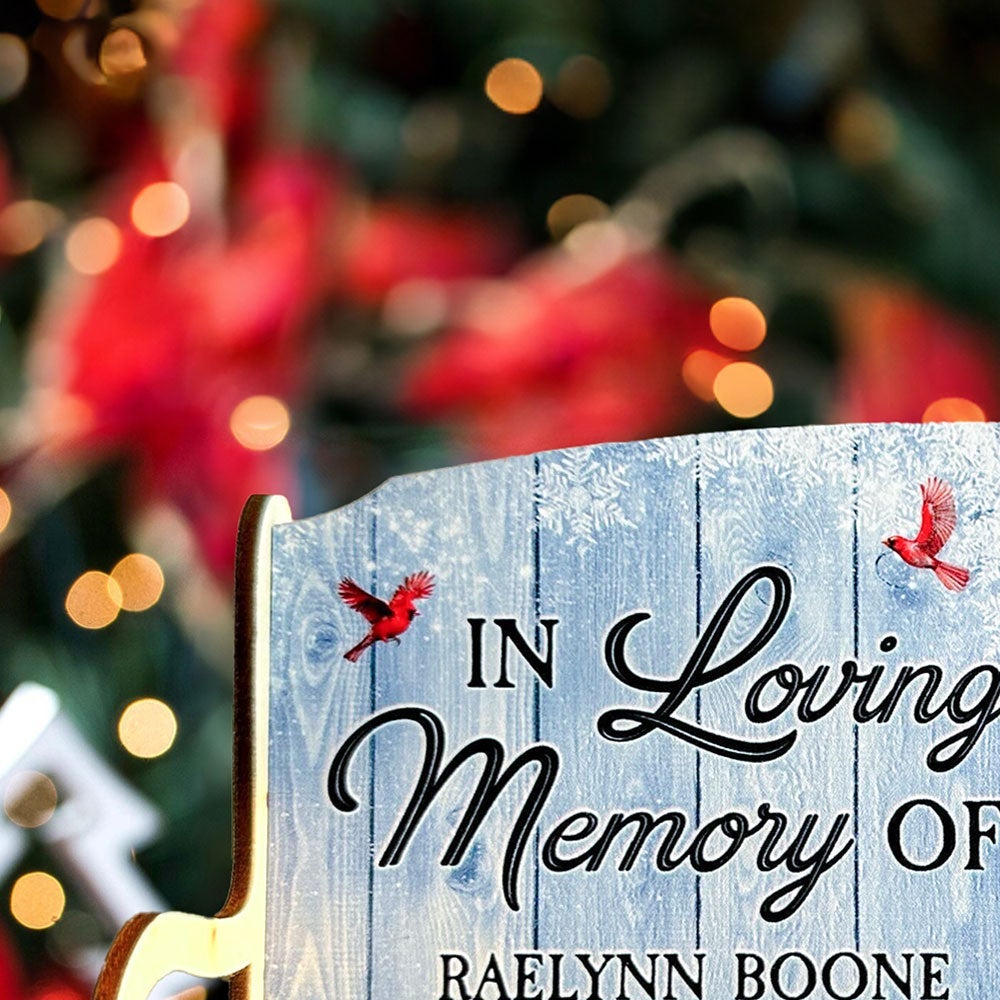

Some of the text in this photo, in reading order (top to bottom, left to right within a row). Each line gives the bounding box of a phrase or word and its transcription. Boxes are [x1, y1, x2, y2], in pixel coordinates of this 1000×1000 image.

[466, 617, 556, 688] IN
[327, 708, 854, 921] Memory
[439, 953, 950, 1000] RAELYNN BOONE
